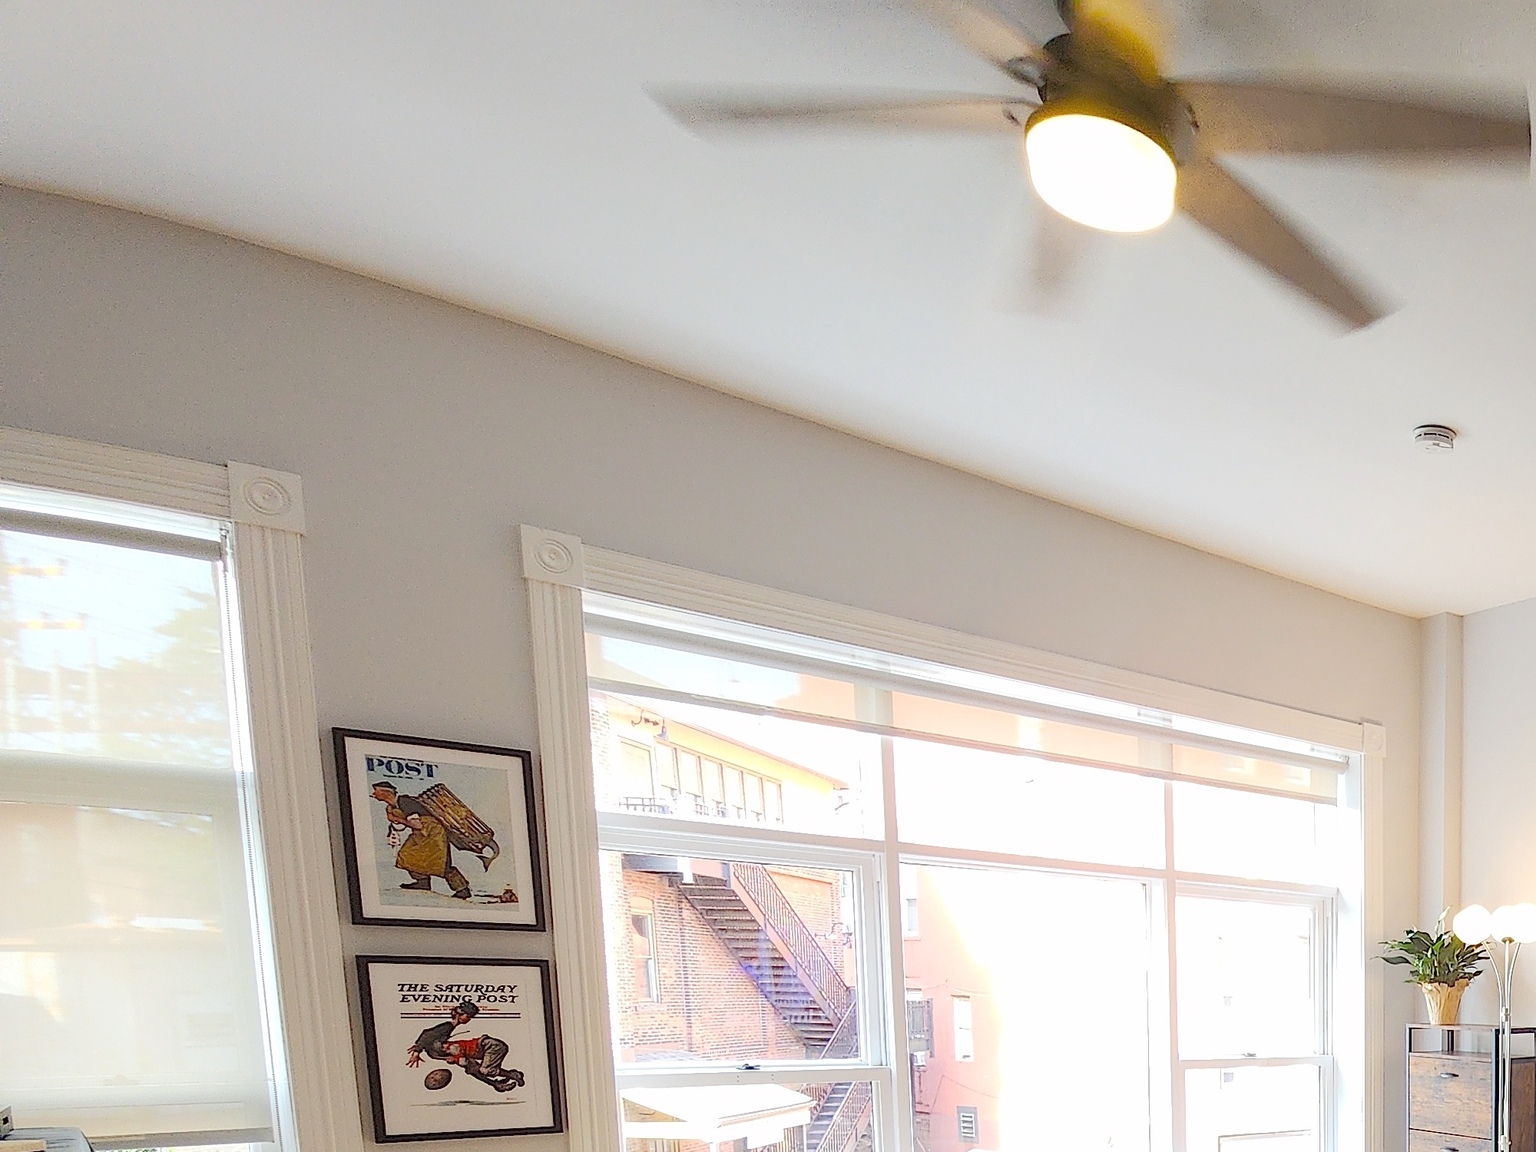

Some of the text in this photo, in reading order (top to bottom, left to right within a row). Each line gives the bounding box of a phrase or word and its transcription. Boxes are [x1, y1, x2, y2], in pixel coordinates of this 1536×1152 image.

[365, 756, 439, 778] POST
[397, 983, 518, 996] THE SATURDAY
[399, 993, 519, 1004] EVENING POST
